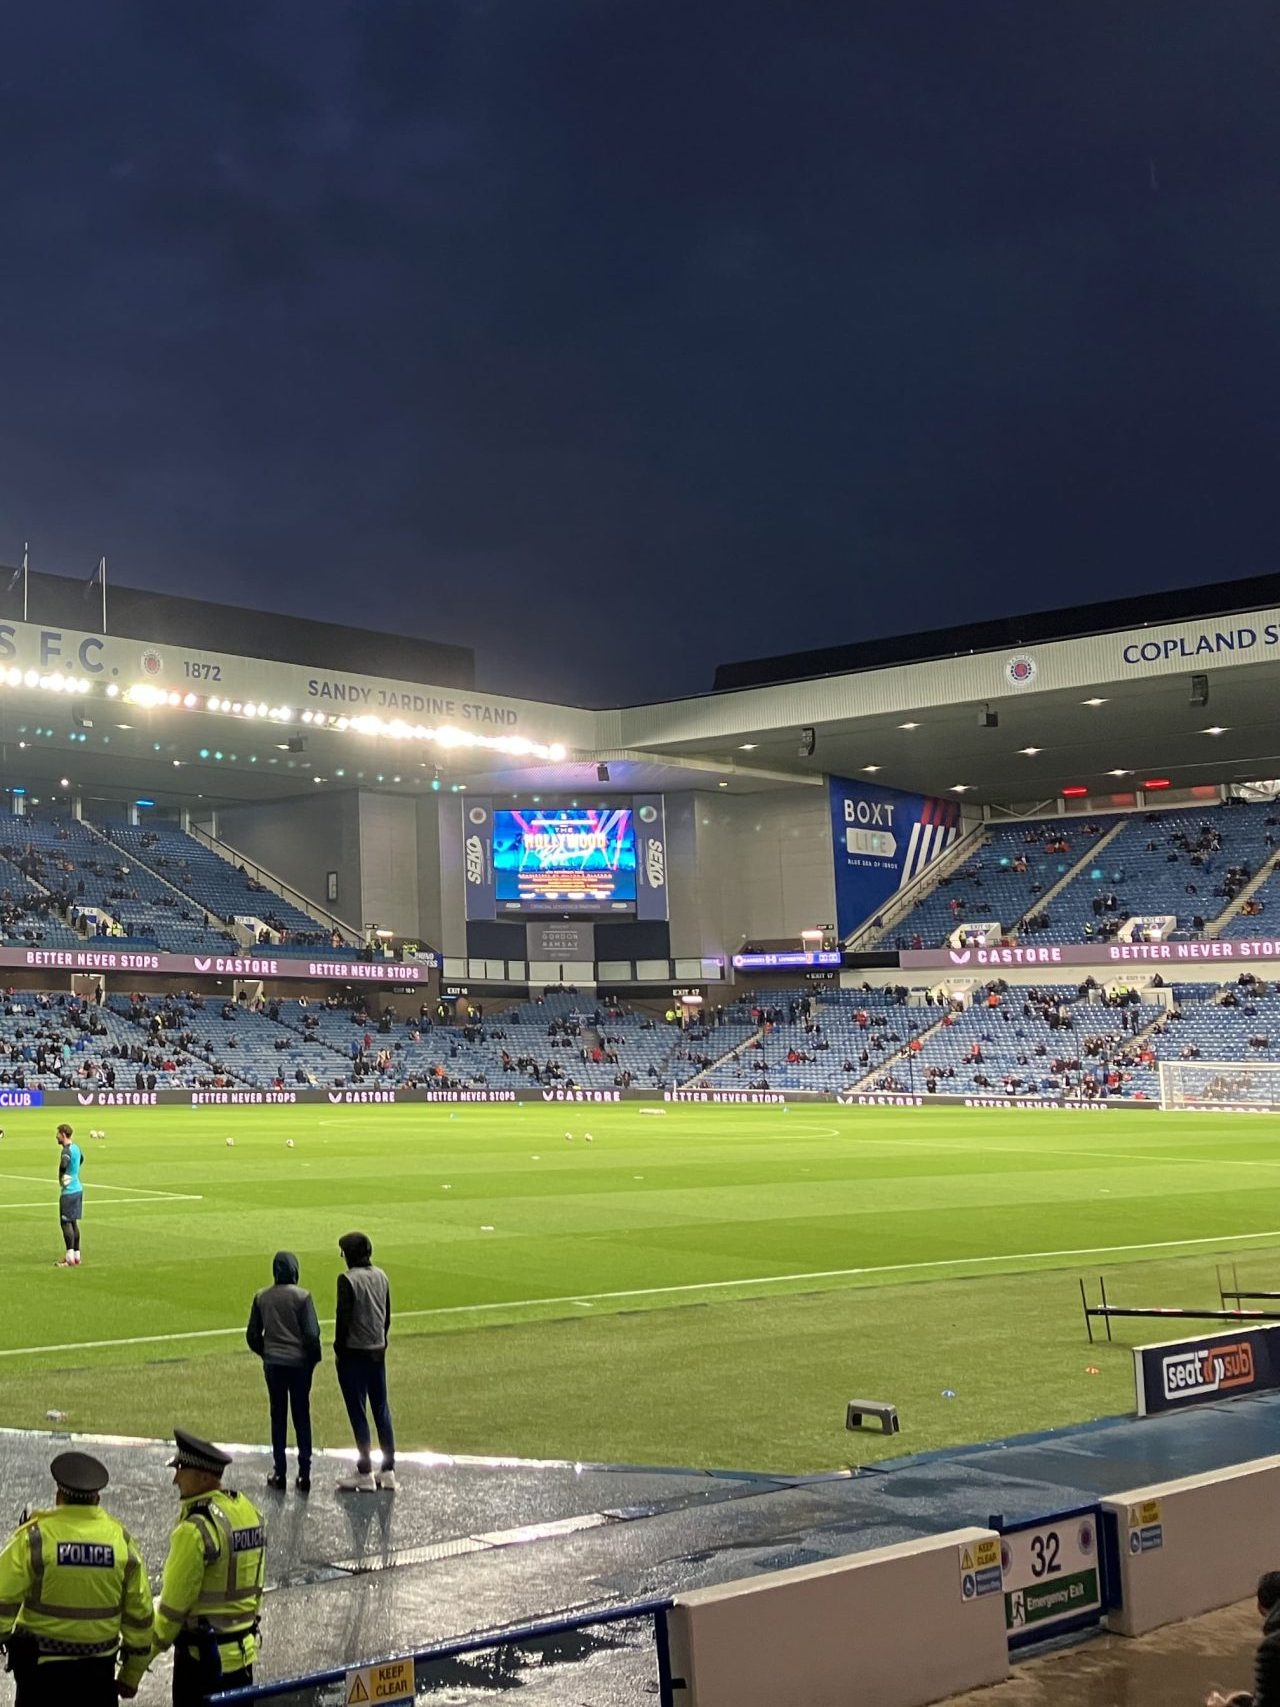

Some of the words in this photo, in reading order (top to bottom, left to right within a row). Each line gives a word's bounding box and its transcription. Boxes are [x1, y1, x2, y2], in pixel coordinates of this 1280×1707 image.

[1123, 628, 1257, 665] COPLAND
[1264, 624, 1280, 644] S
[40, 631, 120, 677] F.C.
[184, 661, 221, 682] 1872
[308, 680, 371, 705] SANDY
[378, 690, 456, 718] JARDINE
[461, 703, 518, 726] STAND
[844, 799, 895, 827] BOXT
[465, 836, 483, 885] SEKO
[648, 838, 665, 889] SEKO
[977, 948, 1062, 963] CASTORE
[1110, 945, 1171, 959] BETTER
[1178, 943, 1233, 957] NEVER
[27, 951, 72, 966] BETTER
[78, 953, 117, 967] NEVER
[121, 954, 159, 969] STOPS
[216, 957, 278, 974] CASTORE
[309, 963, 348, 977] BETTER
[351, 965, 384, 978] NEVER
[387, 966, 419, 979] STOPS
[1, 1092, 31, 1106] CLUB
[98, 1093, 157, 1105] CASTORE
[191, 1092, 228, 1104] BETTER
[231, 1092, 262, 1104] NEVER
[266, 1092, 296, 1103] STOPS
[346, 1091, 395, 1103] CASTORE
[427, 1091, 458, 1102] BETTER
[461, 1091, 487, 1102] NEVER
[489, 1091, 516, 1102] STOPS
[556, 1091, 621, 1102] CASTORE
[664, 1091, 708, 1103] BETTER
[713, 1092, 748, 1104] NEVER
[752, 1093, 785, 1105] STOPS
[858, 1096, 923, 1107] CASTORE
[1142, 1501, 1157, 1513] KEEP
[234, 1529, 263, 1550] POLICE
[978, 1541, 995, 1553] KEEP
[59, 1544, 114, 1565] POLICE
[977, 1553, 997, 1566] CLEAR
[1031, 1532, 1062, 1578] 32
[1027, 1589, 1069, 1611] Emergency
[1070, 1582, 1085, 1603] Exit
[378, 1665, 404, 1681] KEEP
[376, 1680, 408, 1697] CLEAR
